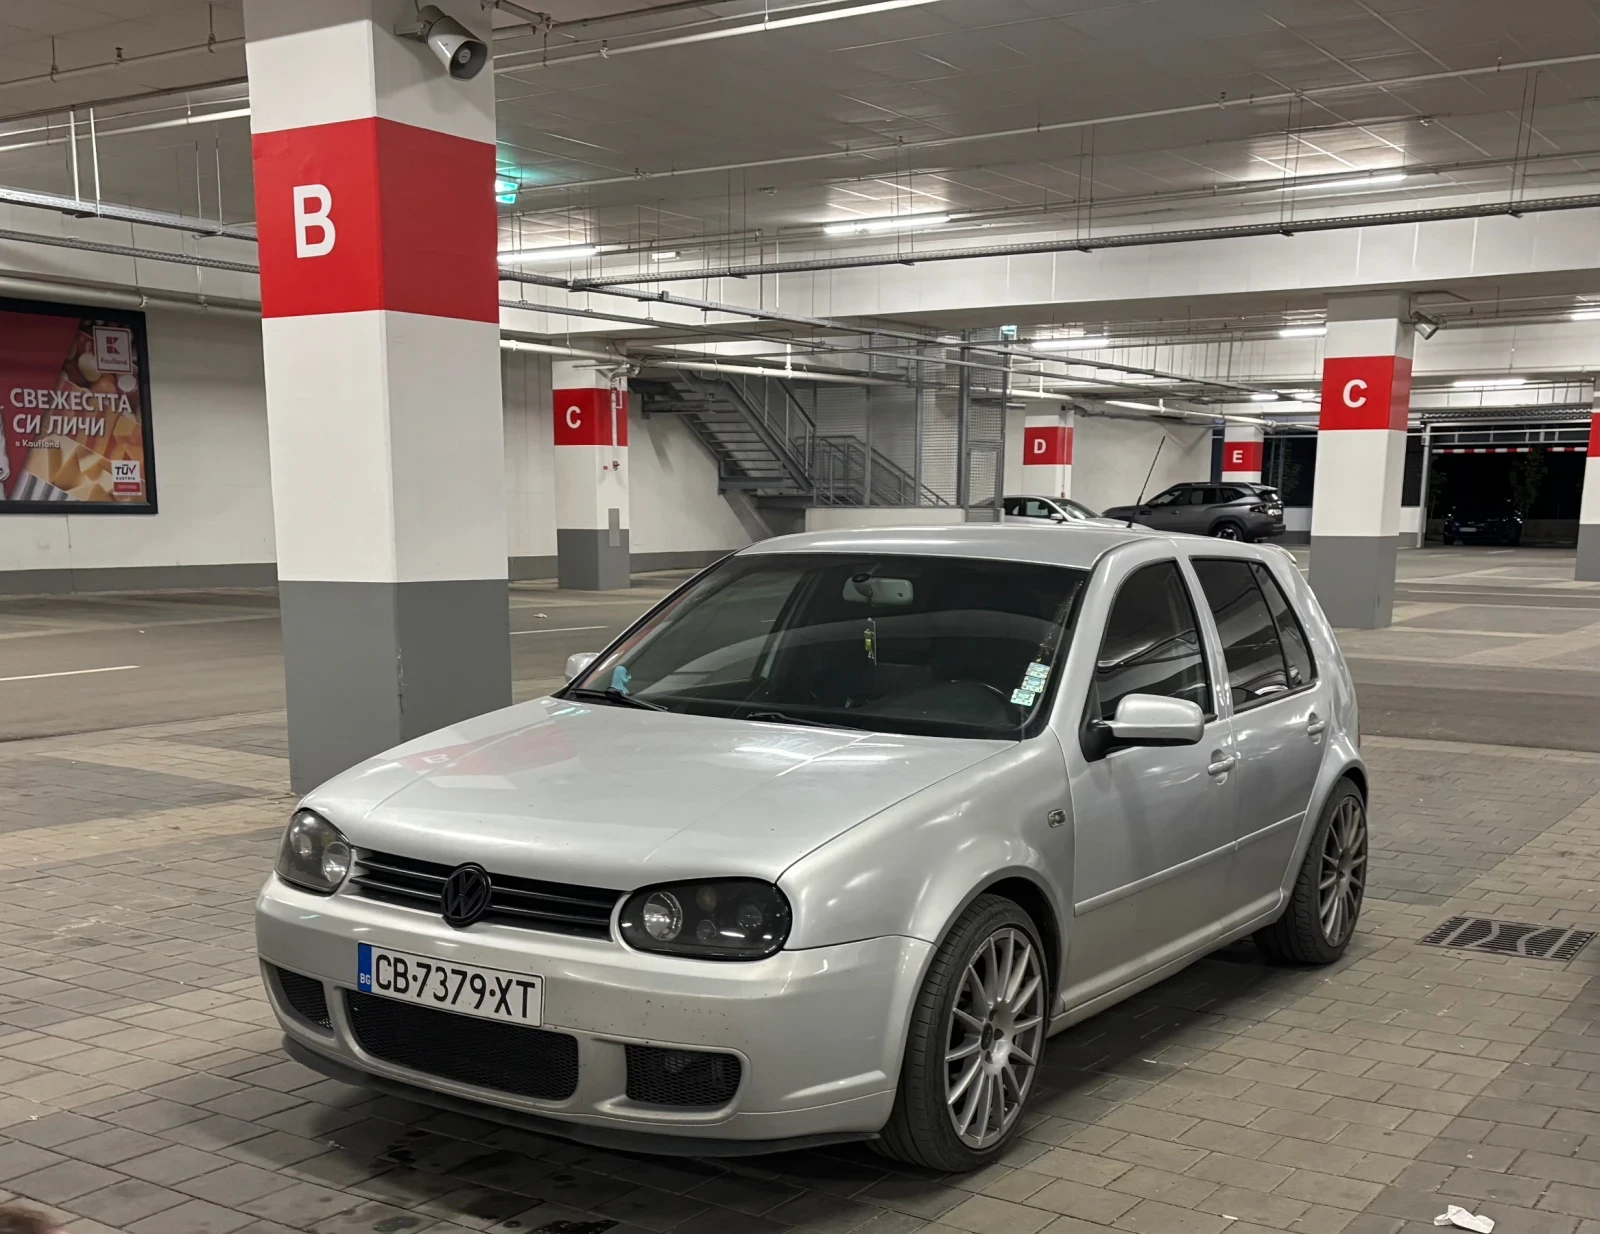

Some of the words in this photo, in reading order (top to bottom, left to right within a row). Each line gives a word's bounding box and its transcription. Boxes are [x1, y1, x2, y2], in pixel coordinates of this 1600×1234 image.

[293, 184, 336, 259] B
[10, 387, 132, 413] СВЕЖЕСТТА
[1342, 378, 1368, 408] C
[12, 413, 41, 434] СИ
[47, 415, 105, 437] ЛИЧИ
[566, 405, 581, 429] C
[22, 439, 60, 448] Kaufland
[1033, 438, 1047, 454] D
[1232, 449, 1244, 464] E
[359, 972, 372, 986] BG
